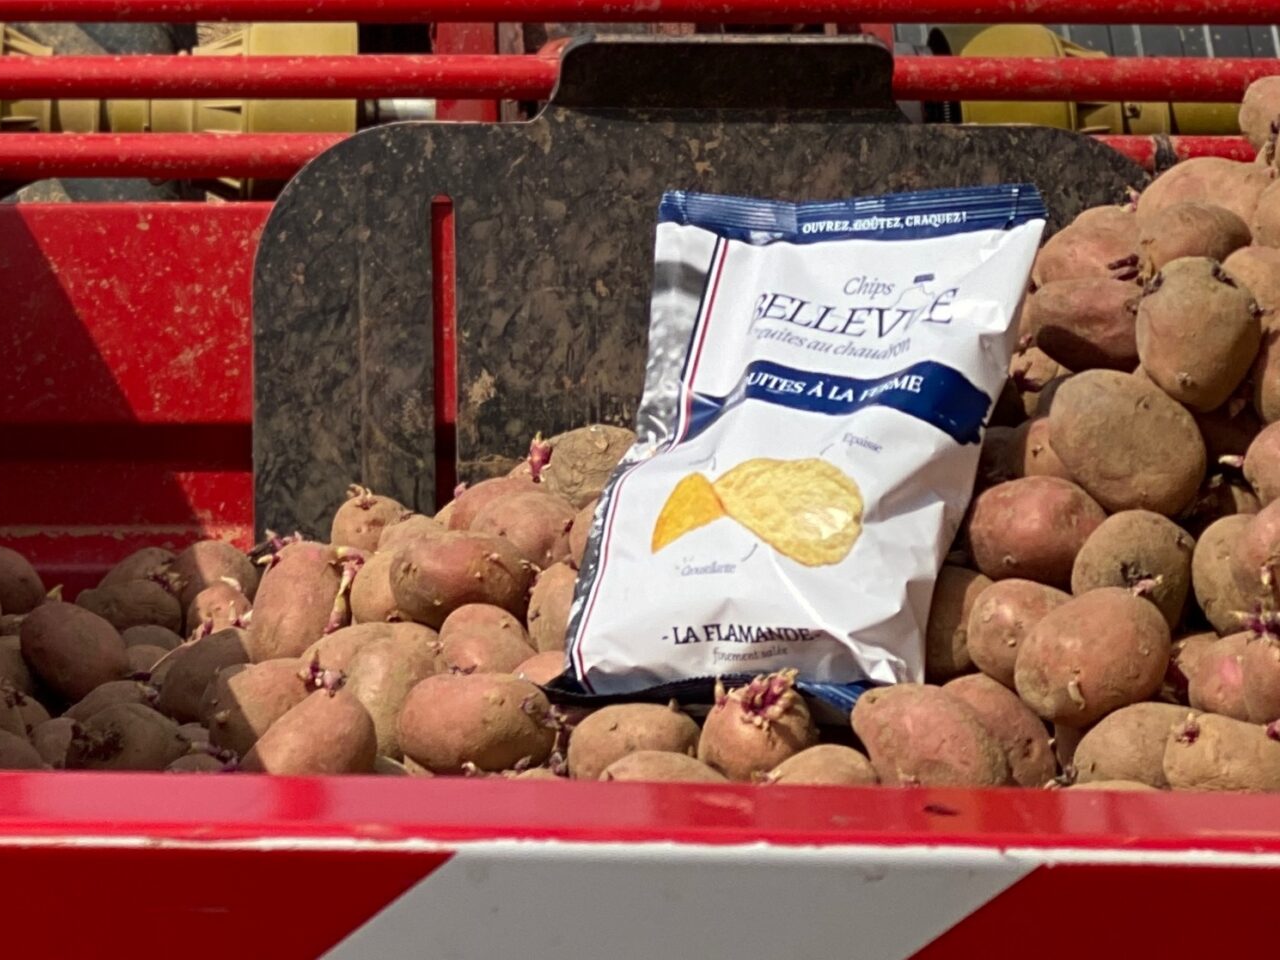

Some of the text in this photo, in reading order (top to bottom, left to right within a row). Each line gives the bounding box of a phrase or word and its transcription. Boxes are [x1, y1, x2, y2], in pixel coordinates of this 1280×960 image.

[843, 274, 895, 300] Chips
[806, 340, 830, 354] au
[746, 371, 807, 394] UITES
[827, 385, 853, 403] LA
[672, 625, 701, 645] LA
[702, 623, 814, 644] FLAMANDE
